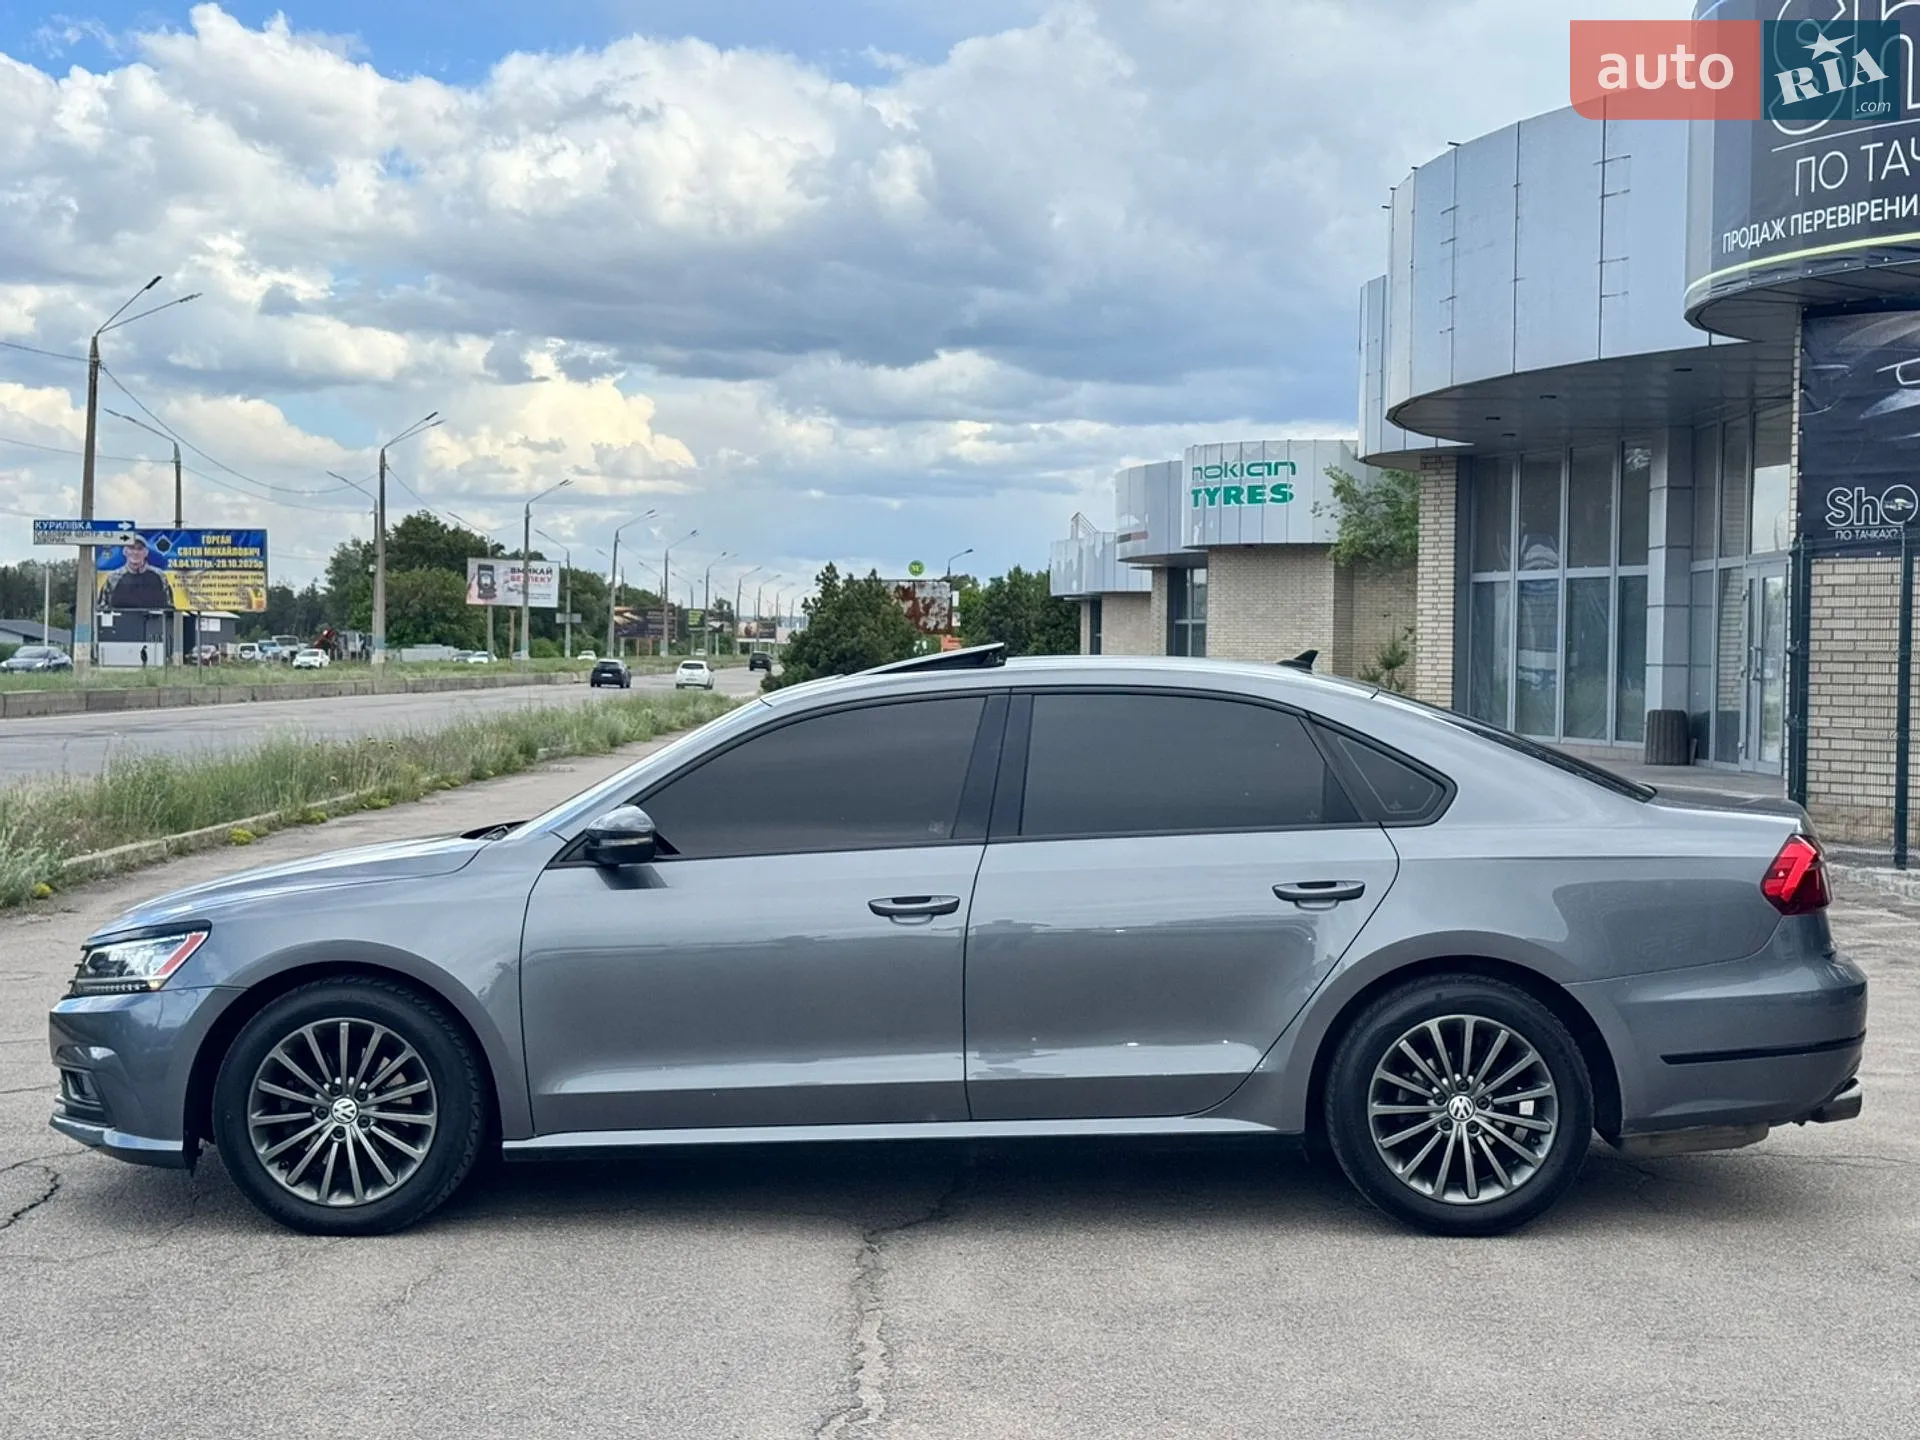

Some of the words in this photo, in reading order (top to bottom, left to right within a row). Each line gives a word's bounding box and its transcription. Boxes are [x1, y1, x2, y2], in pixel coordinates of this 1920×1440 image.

[1795, 151, 1848, 196] ПО
[1722, 216, 1786, 254] ПРОДАЖ
[1790, 193, 1920, 237] ПЕРЕВІРЕНИ
[1192, 461, 1296, 481] nokian
[1191, 483, 1294, 508] TYRES
[35, 521, 93, 530] КУРИЛІВКА
[1834, 530, 1852, 541] ПО
[1855, 528, 1899, 540] ТАЧКАХ?
[510, 575, 552, 583] БЕПЕКУ
